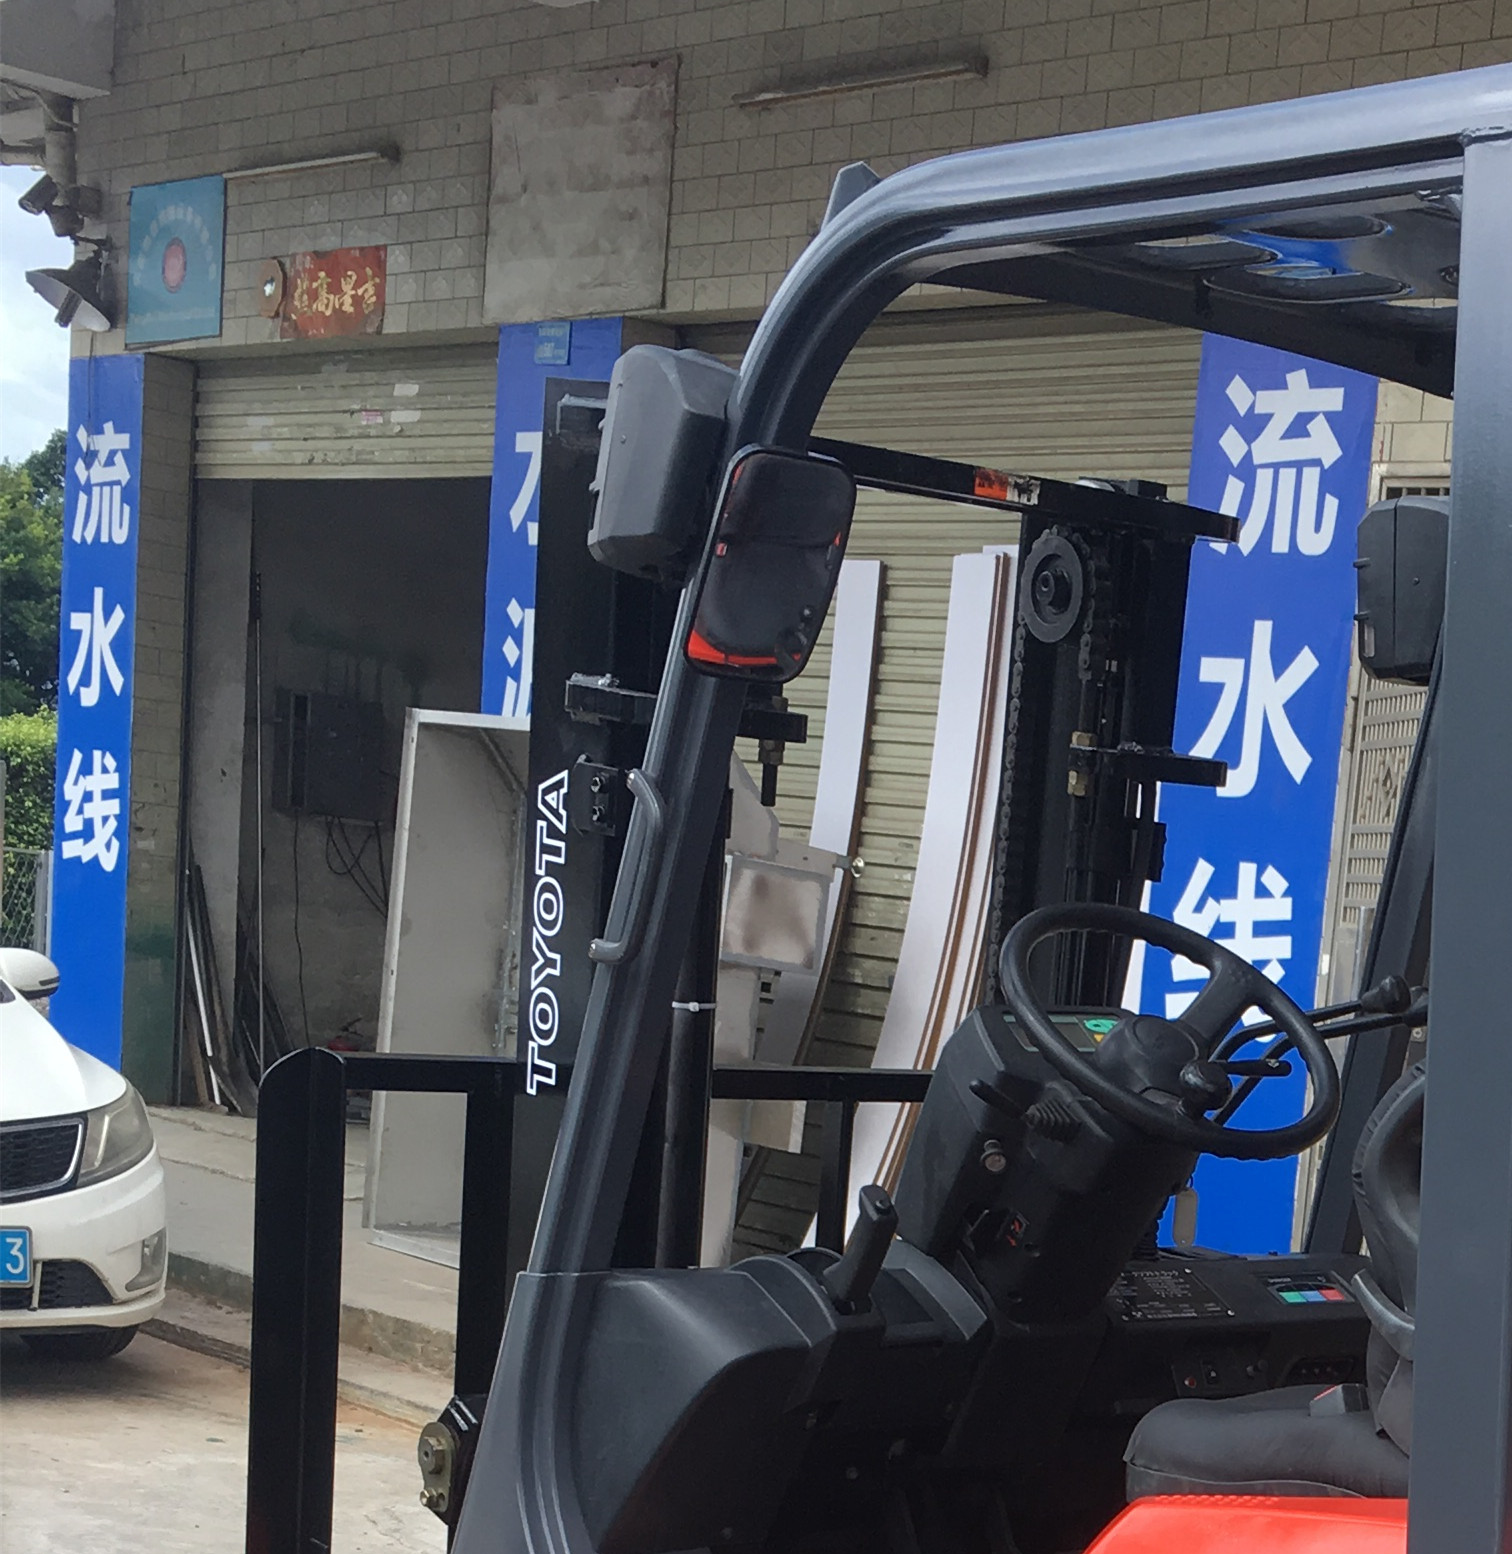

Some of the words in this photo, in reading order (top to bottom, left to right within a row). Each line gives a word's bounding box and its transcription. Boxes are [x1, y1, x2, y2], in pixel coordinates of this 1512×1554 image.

[62, 421, 131, 872] 流水线
[526, 769, 569, 1096] TOYOTA
[6, 1237, 24, 1274] 3
